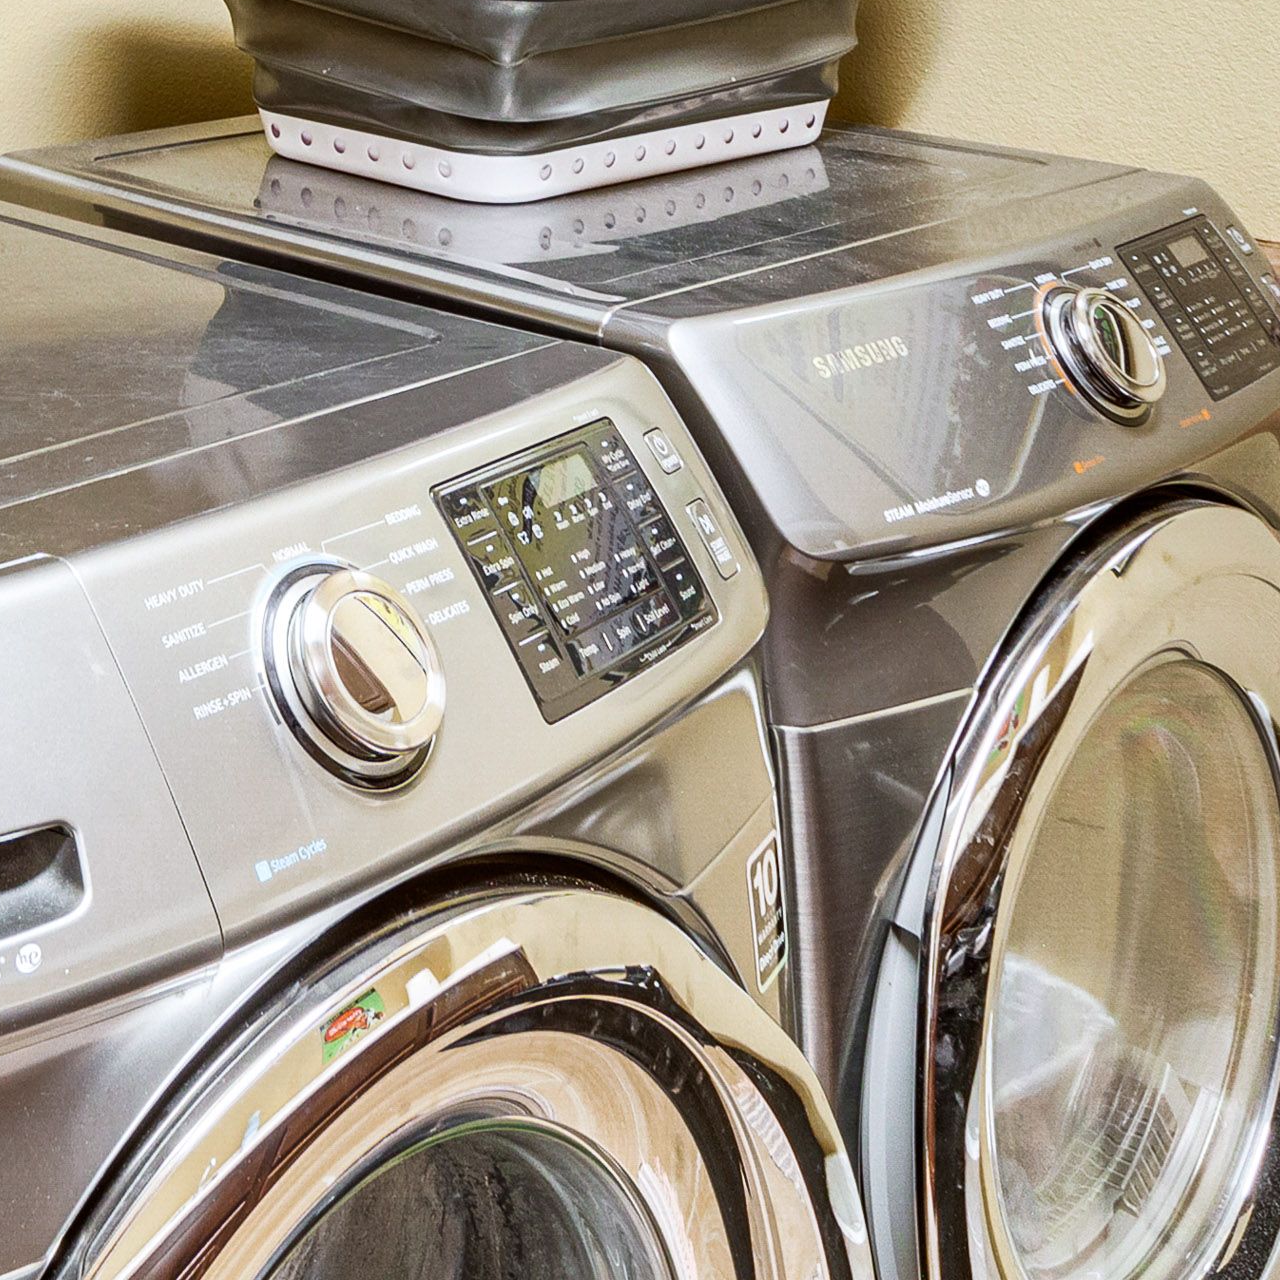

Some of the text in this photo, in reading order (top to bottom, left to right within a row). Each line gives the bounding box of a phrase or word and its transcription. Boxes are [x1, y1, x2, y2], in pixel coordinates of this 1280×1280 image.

[812, 335, 910, 379] SAMSUNG
[384, 506, 422, 525] BEDDING
[455, 514, 473, 529] Extra
[271, 541, 311, 562] NORMAL
[388, 538, 439, 565] QUICK WASH
[405, 568, 455, 595] PERM PRESS
[483, 562, 501, 577] Extra
[144, 578, 205, 611] HEAVY DUTY
[428, 600, 470, 626] DELICATES
[522, 603, 539, 619] Only
[161, 621, 207, 649] SANITIZE
[178, 653, 228, 683] ALLERGEN
[270, 838, 328, 874] Steam Cycles
[753, 848, 778, 917] 10
